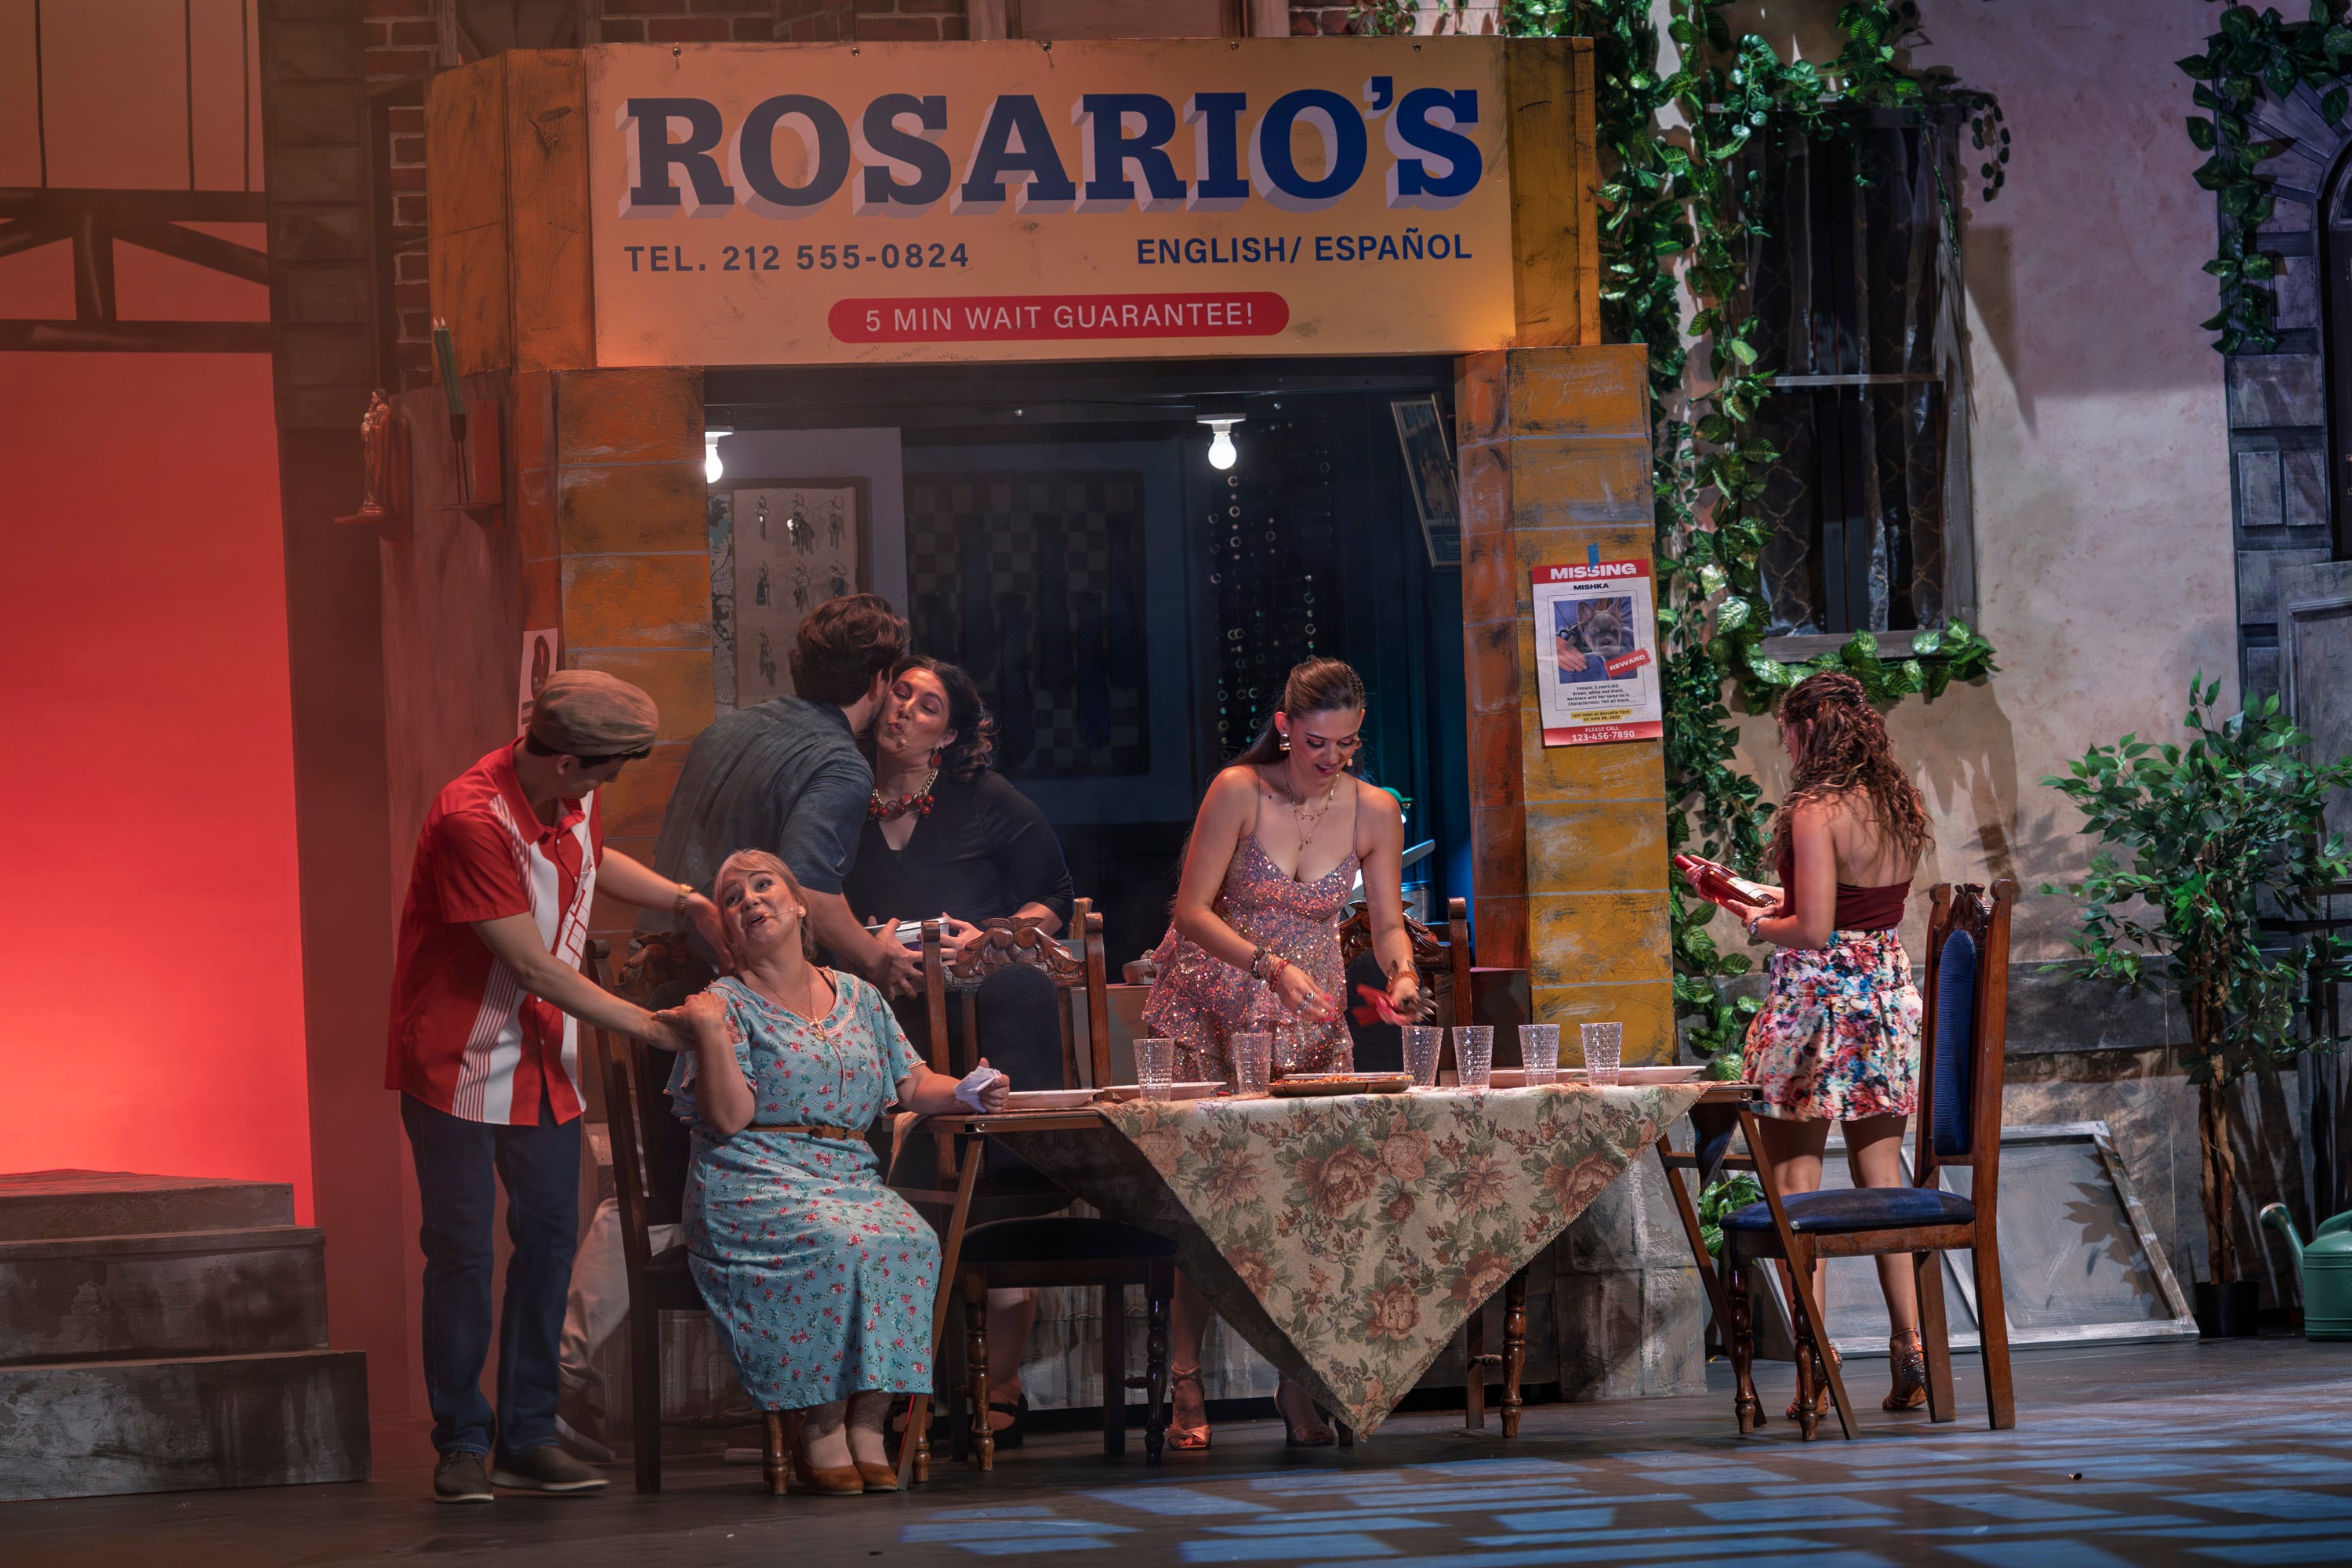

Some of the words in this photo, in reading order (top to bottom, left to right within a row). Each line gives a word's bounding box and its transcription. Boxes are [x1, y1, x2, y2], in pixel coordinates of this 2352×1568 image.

[615, 76, 1483, 219] ROSARIO'S
[625, 245, 706, 272] TEL.
[722, 245, 780, 271] 212
[796, 242, 969, 270] 555-0824
[1137, 236, 1301, 264] ENGLISH/
[1315, 227, 1472, 262] ESPAÑOL
[866, 310, 880, 332] 5
[895, 307, 952, 331] MIN
[965, 306, 1042, 330] WAIT
[1053, 302, 1254, 328] GUARANTEE!
[1550, 563, 1637, 580] MISSING
[1573, 583, 1609, 591] MISHKA
[1610, 655, 1646, 670] REWARD
[1572, 730, 1635, 742] 123-456-7890
